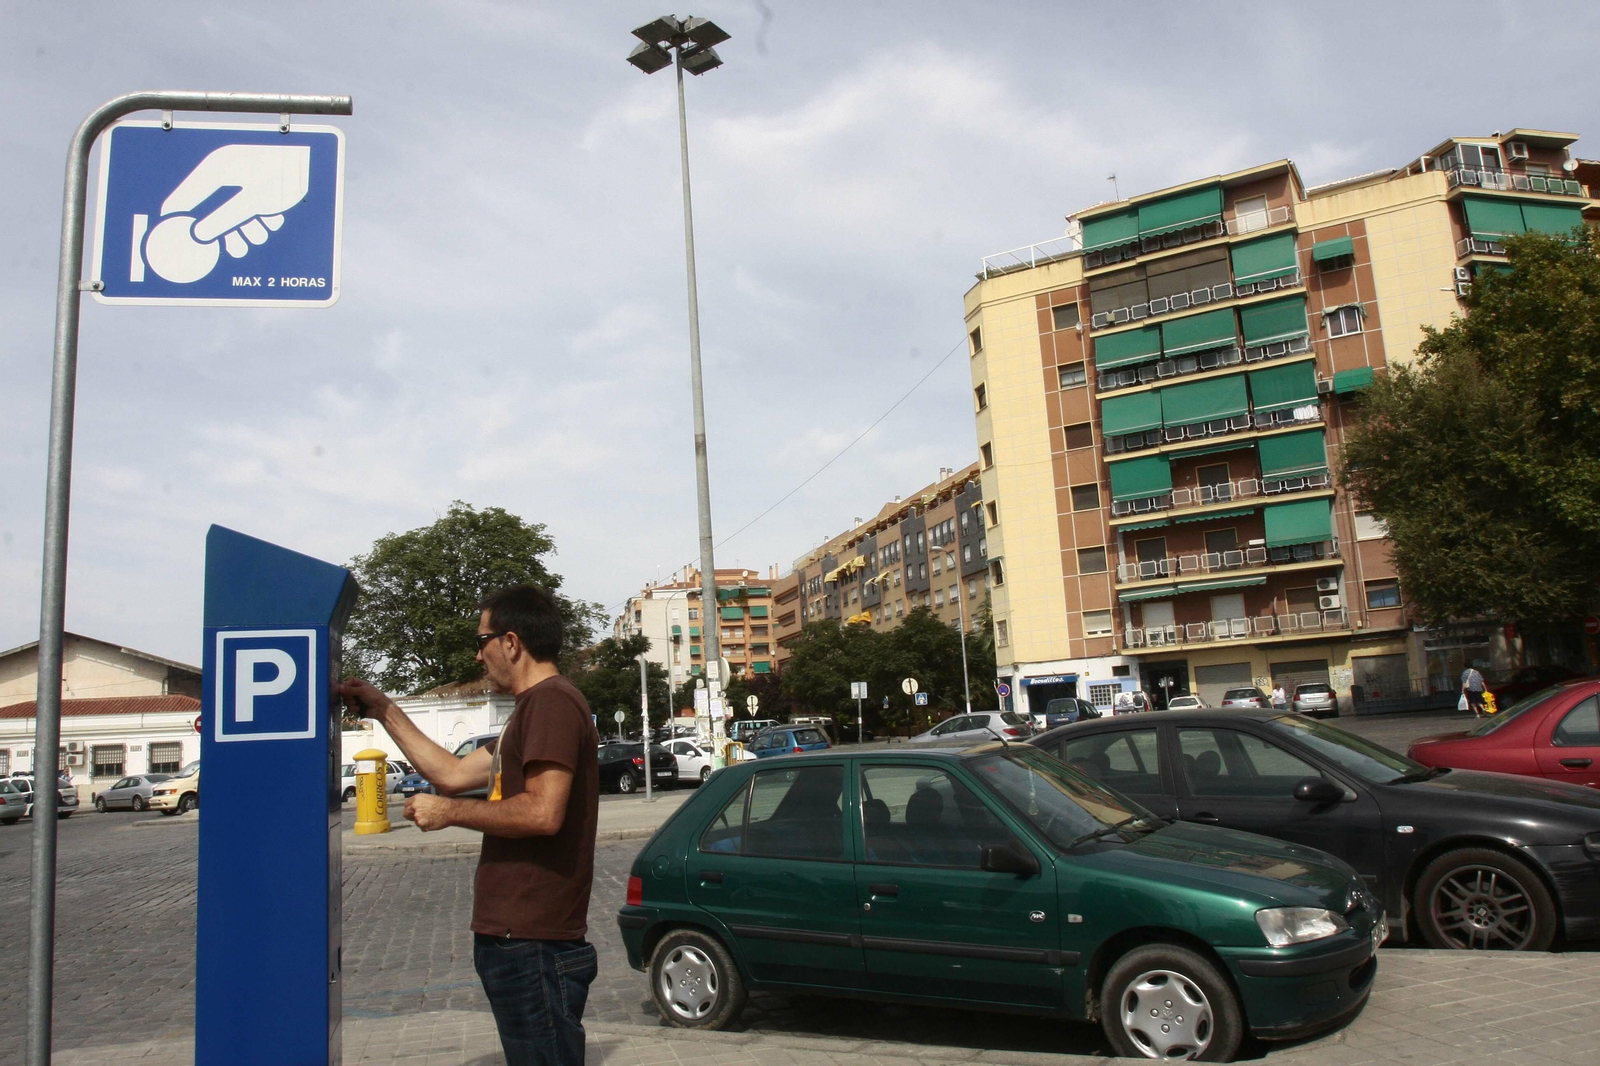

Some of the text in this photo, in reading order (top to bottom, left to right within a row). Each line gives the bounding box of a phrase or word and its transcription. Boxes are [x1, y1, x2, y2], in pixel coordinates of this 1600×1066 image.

[232, 277, 326, 287] MAX 2 HORAS
[235, 649, 297, 722] P
